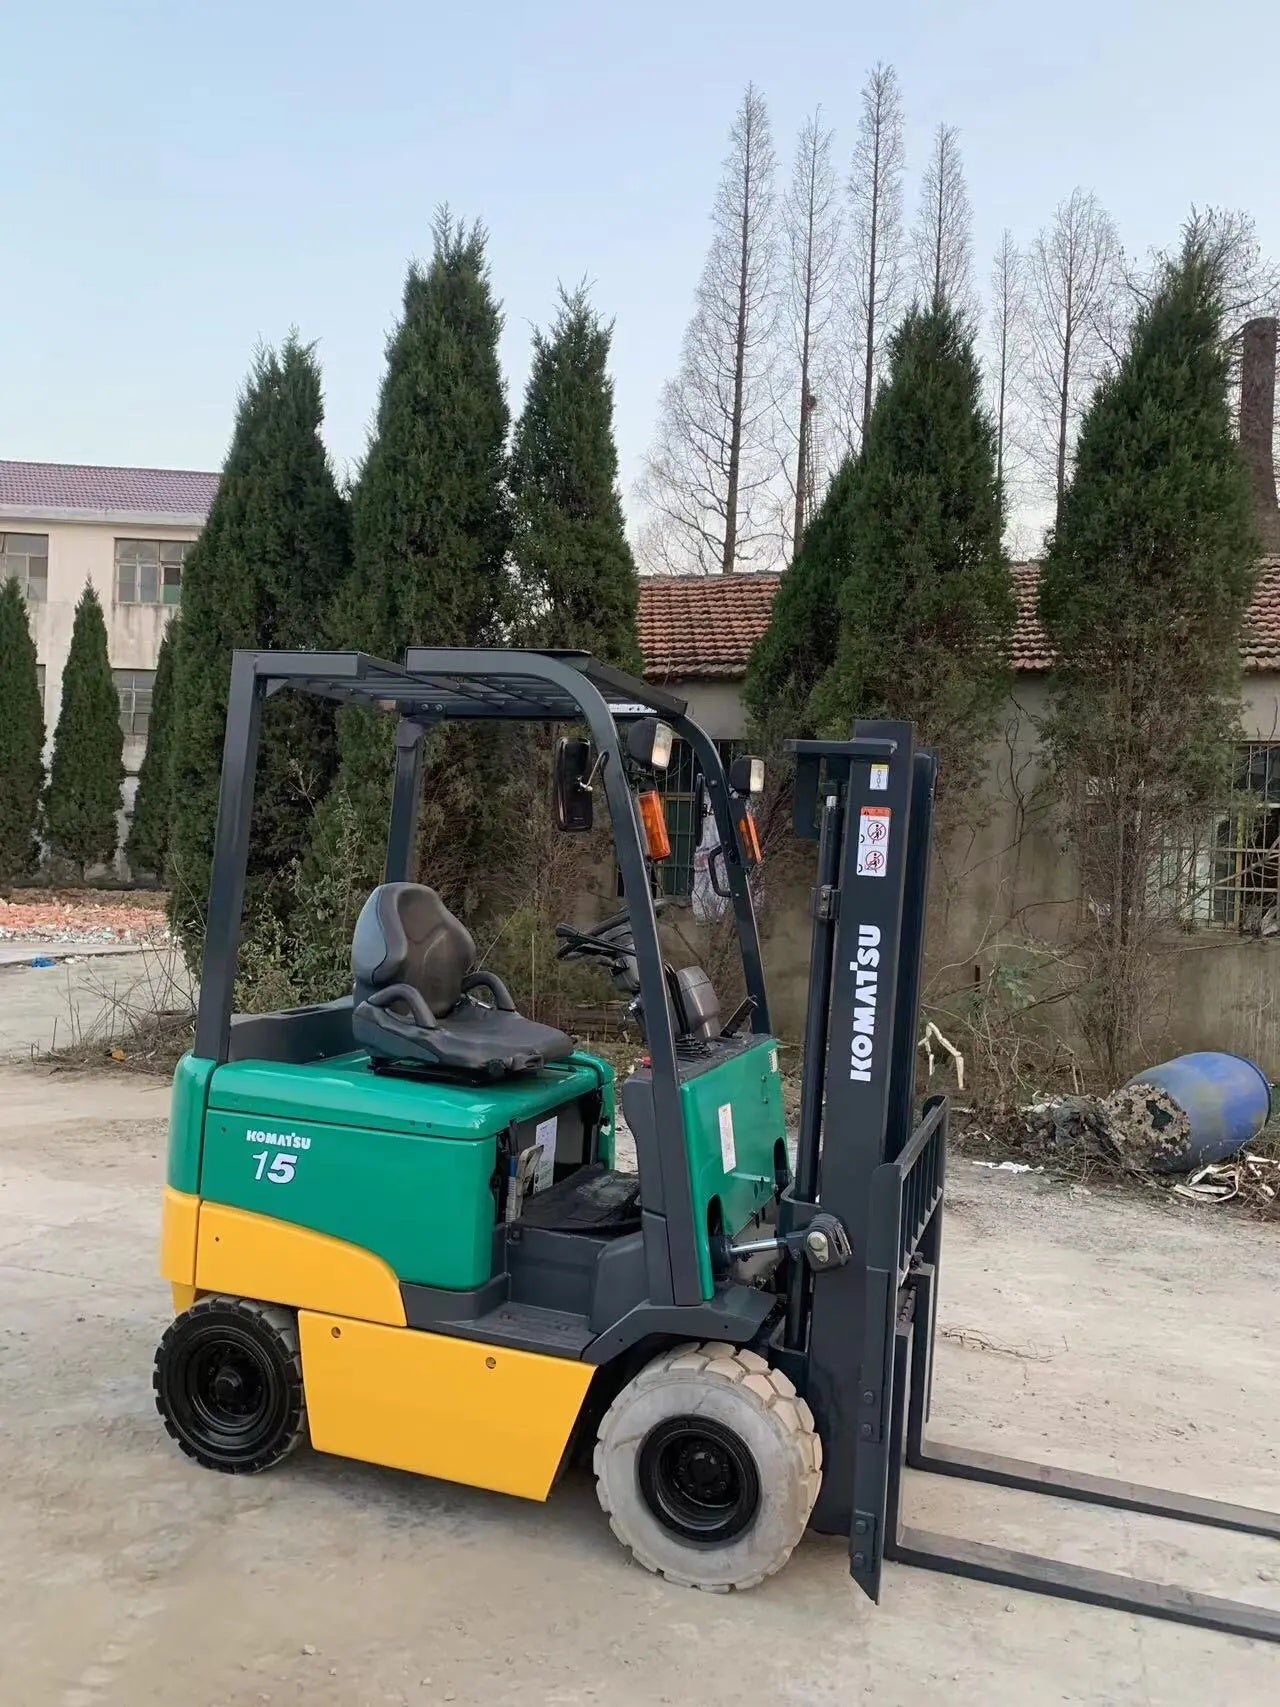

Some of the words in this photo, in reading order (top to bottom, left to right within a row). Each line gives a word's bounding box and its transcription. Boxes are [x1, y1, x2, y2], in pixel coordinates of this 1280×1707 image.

[849, 924, 882, 1082] KOMATSU
[246, 1129, 312, 1150] KOMATSU
[252, 1150, 298, 1184] 15
